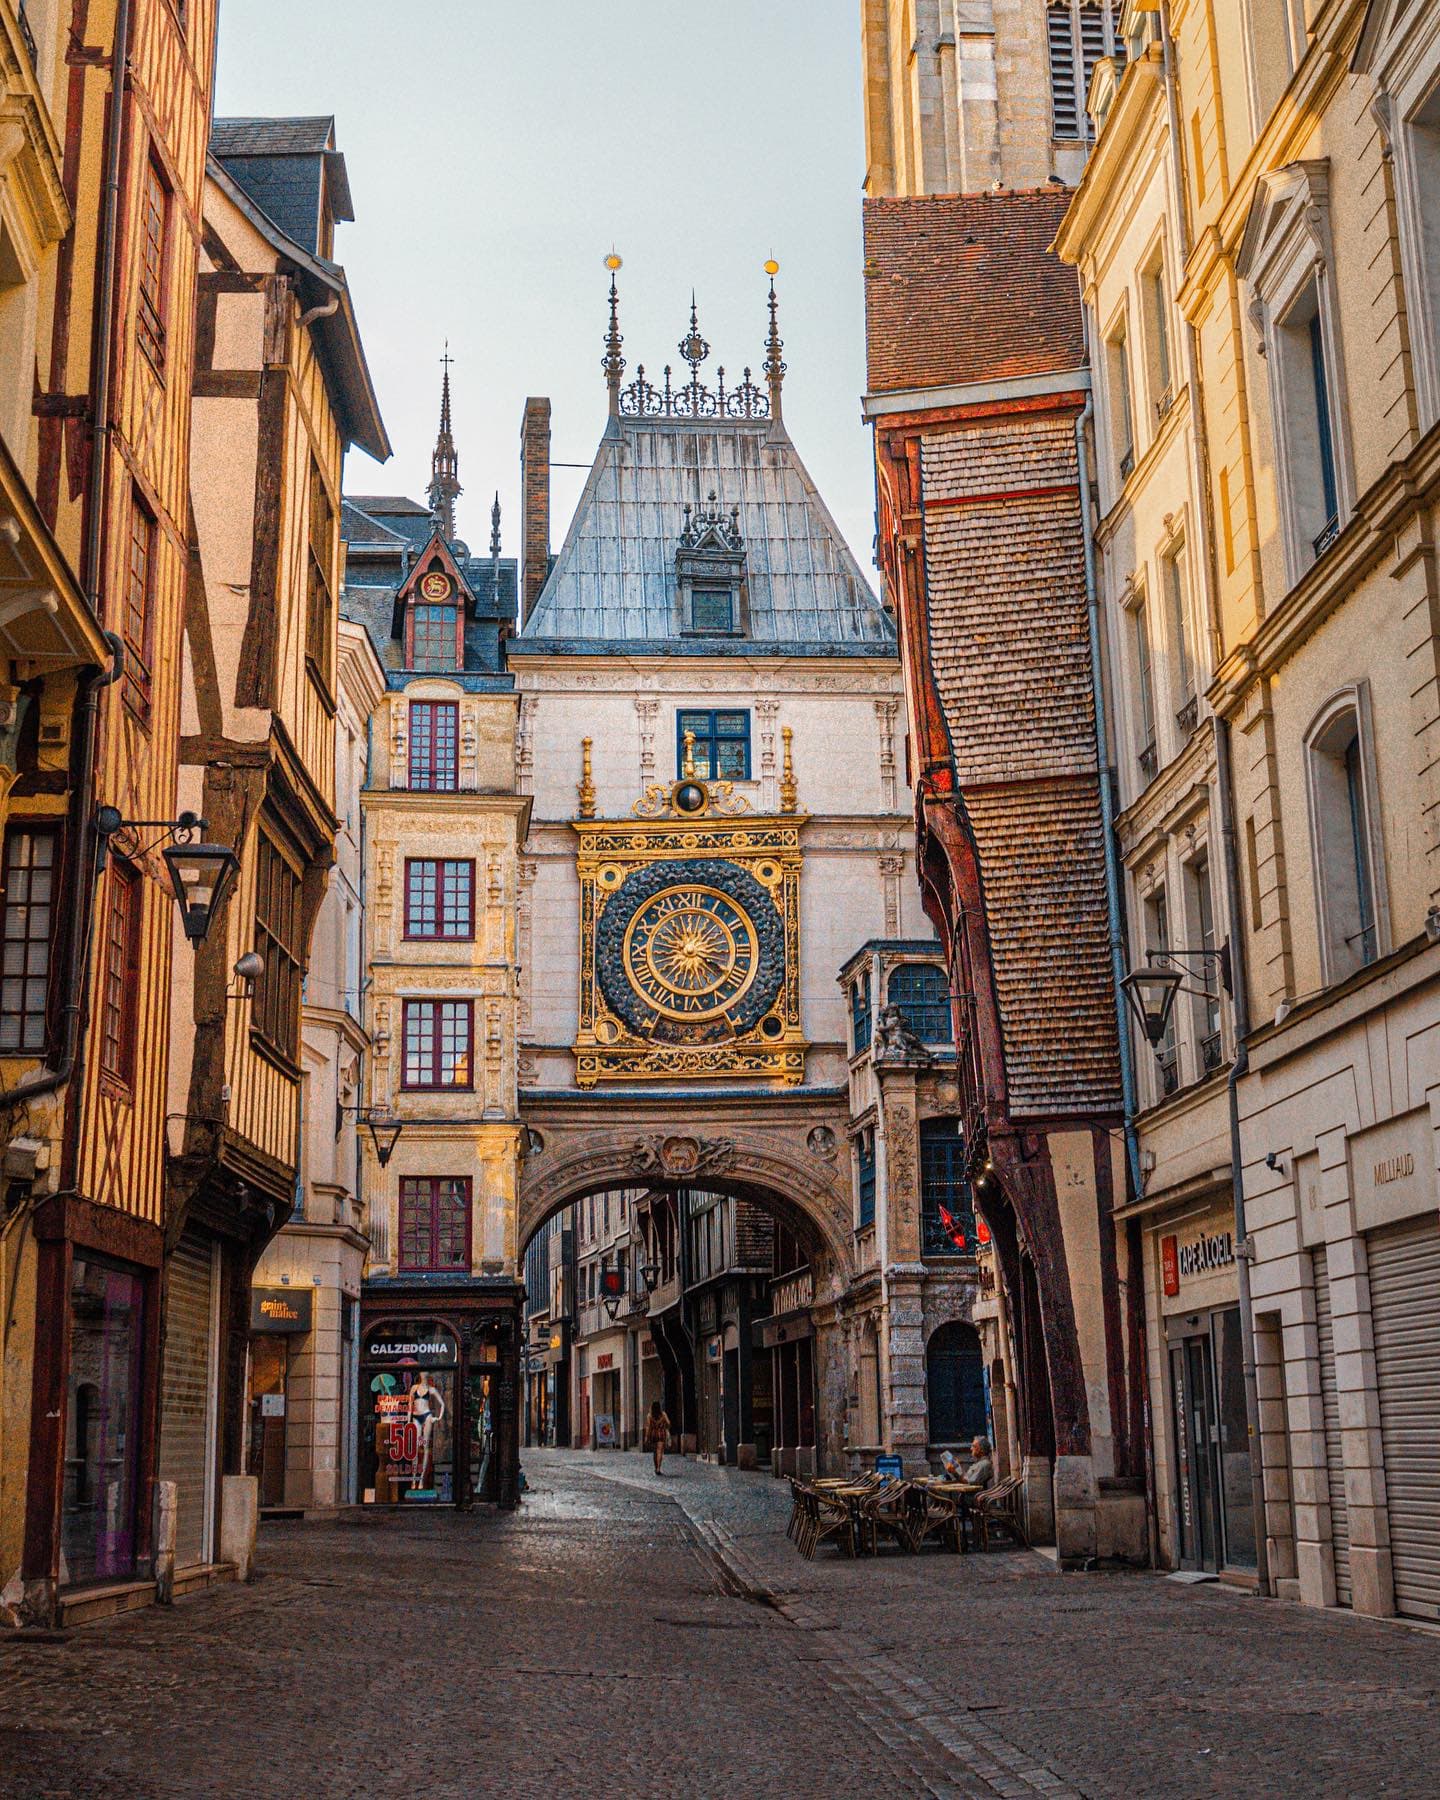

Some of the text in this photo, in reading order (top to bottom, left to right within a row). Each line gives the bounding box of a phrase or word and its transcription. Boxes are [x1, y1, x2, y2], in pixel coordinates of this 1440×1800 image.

[652, 897, 675, 919] XI
[677, 893, 702, 909] XII
[711, 899, 721, 914] I
[636, 917, 657, 936] X
[727, 917, 744, 931] II
[631, 943, 647, 962] IX
[736, 943, 751, 958] III
[634, 963, 656, 994] VIII
[726, 965, 748, 988] IIII
[653, 986, 676, 1009] VII
[683, 995, 704, 1011] VI
[713, 990, 728, 1006] V
[1177, 1243, 1200, 1275] TAPE
[370, 1343, 448, 1355] CALZEDONIA
[1176, 1379, 1185, 1416] ANS
[1183, 1477, 1192, 1527] MODE
